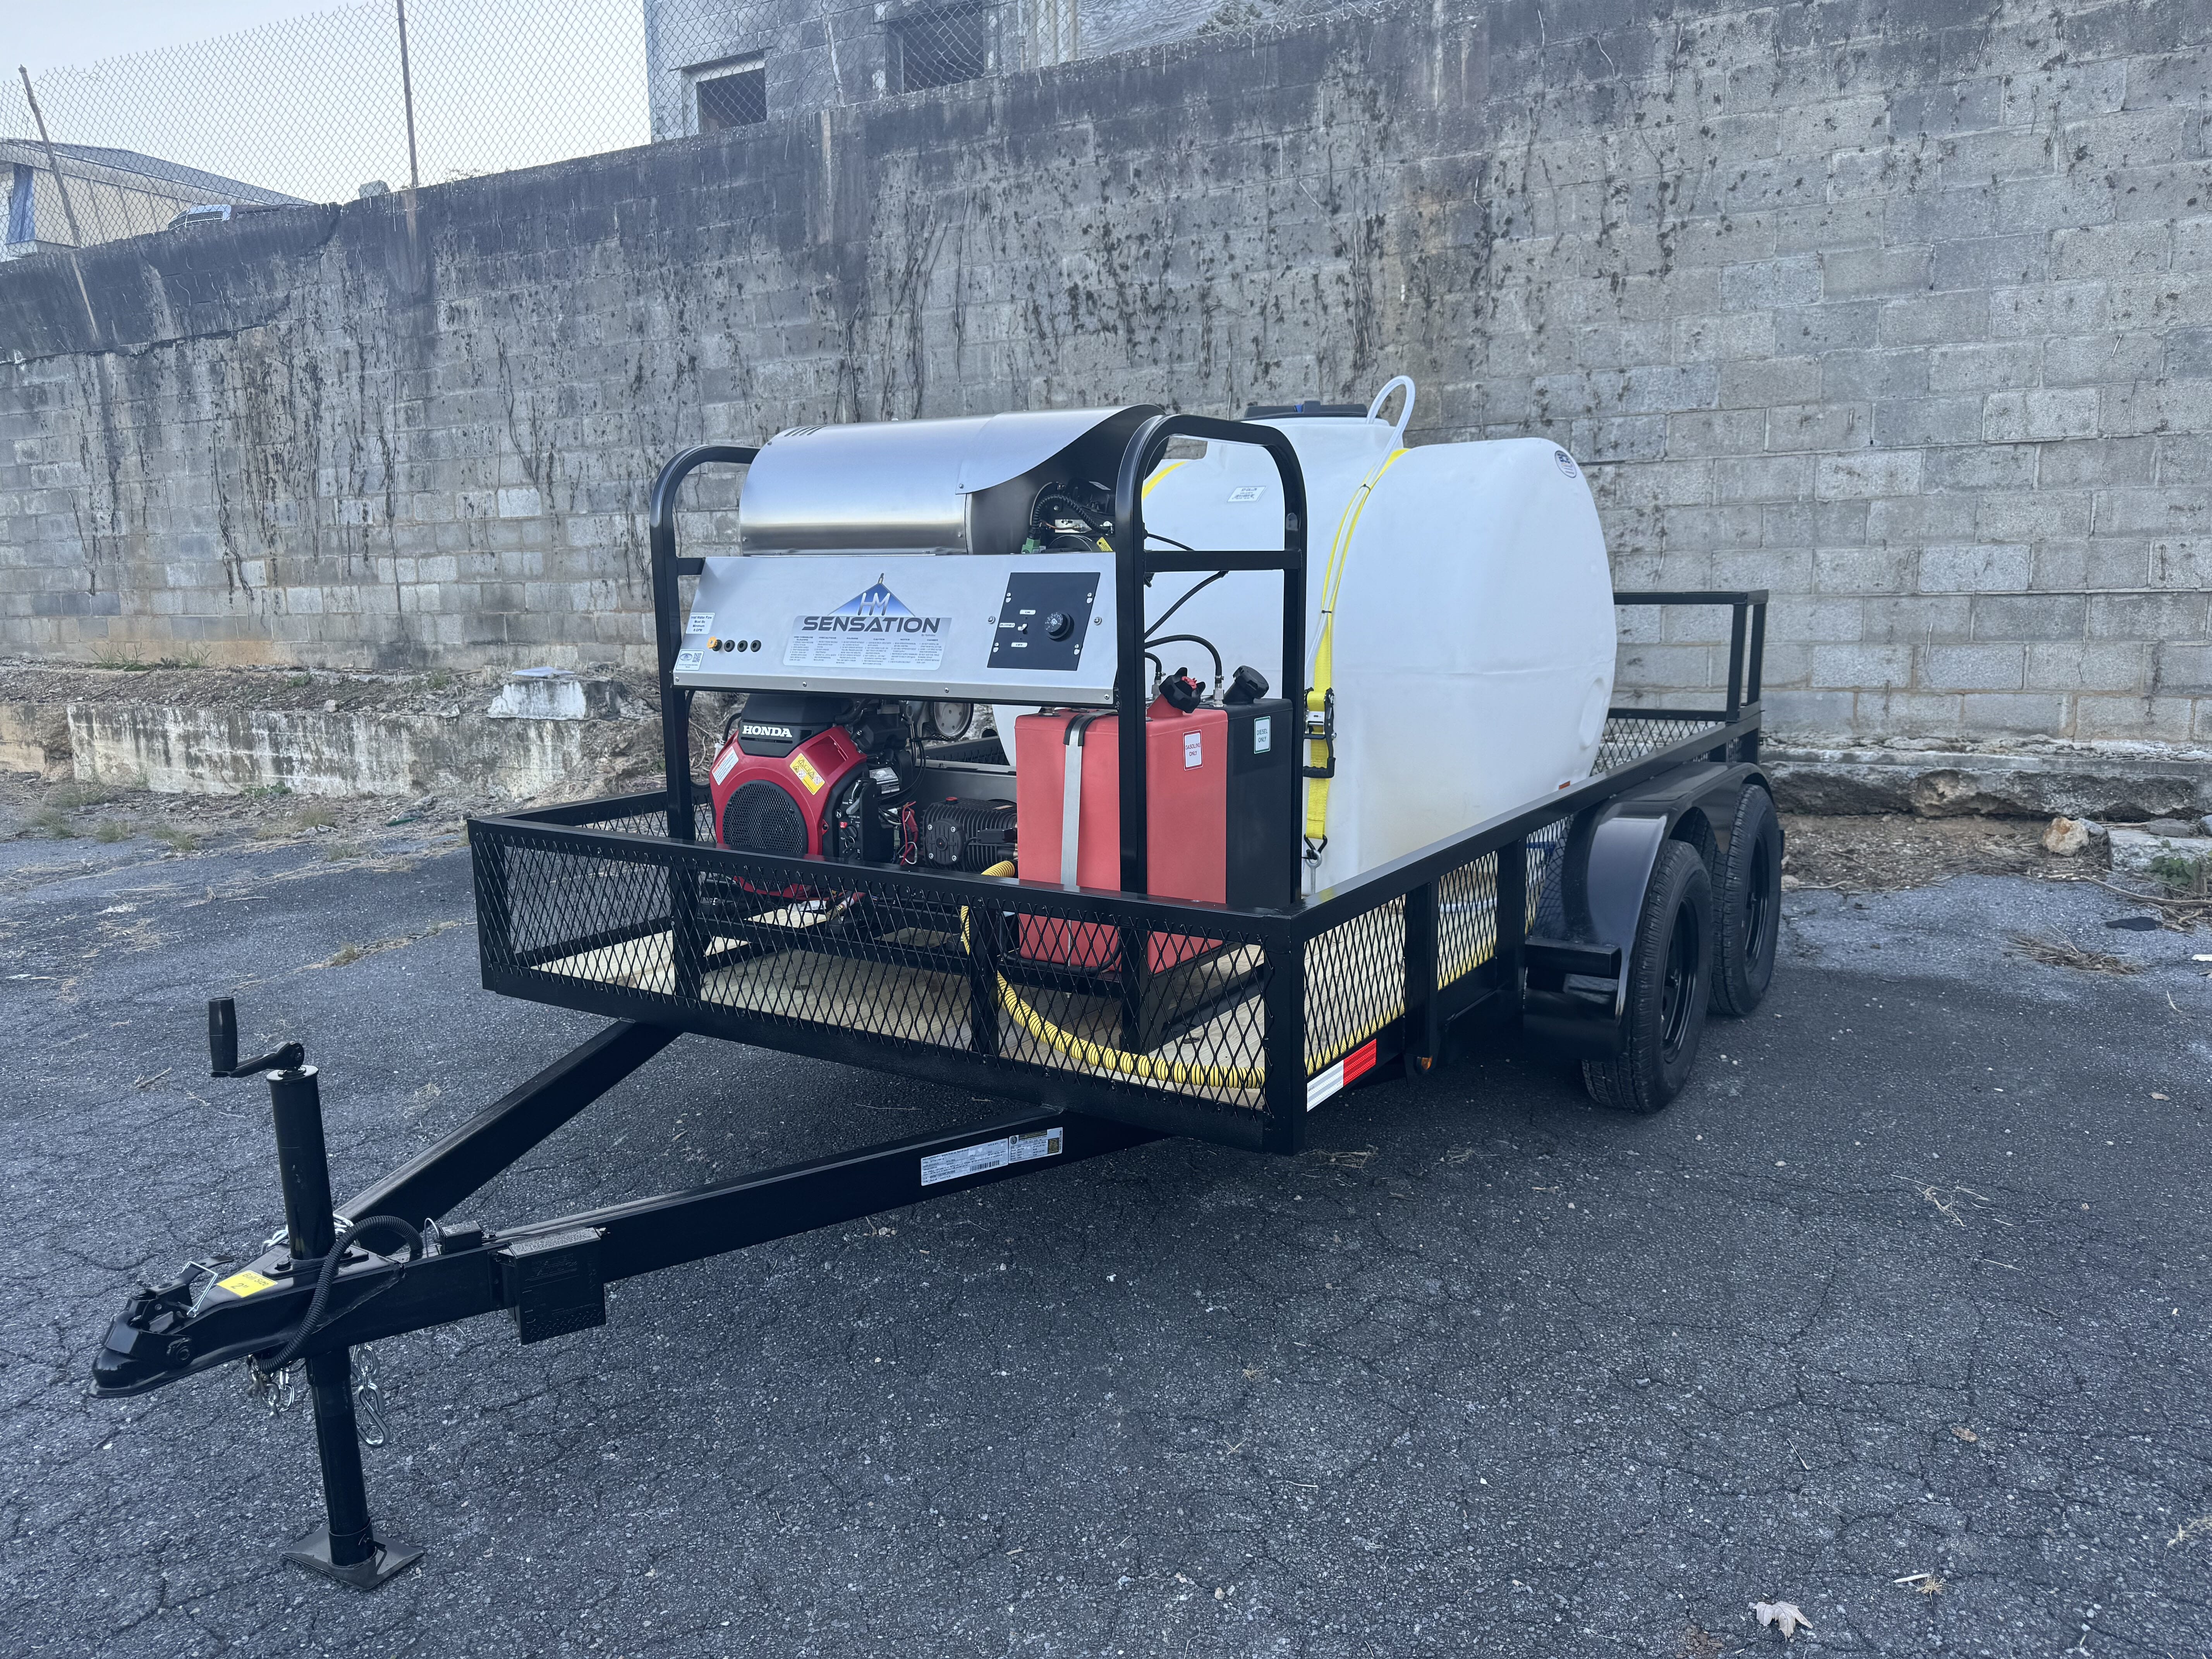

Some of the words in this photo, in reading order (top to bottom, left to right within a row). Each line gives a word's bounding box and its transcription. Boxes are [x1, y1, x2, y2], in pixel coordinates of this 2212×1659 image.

[857, 592, 890, 616] HM
[802, 616, 941, 634] SENSATION
[742, 725, 793, 738] HONDA
[242, 1273, 257, 1281] Ball
[254, 1278, 270, 1286] Size
